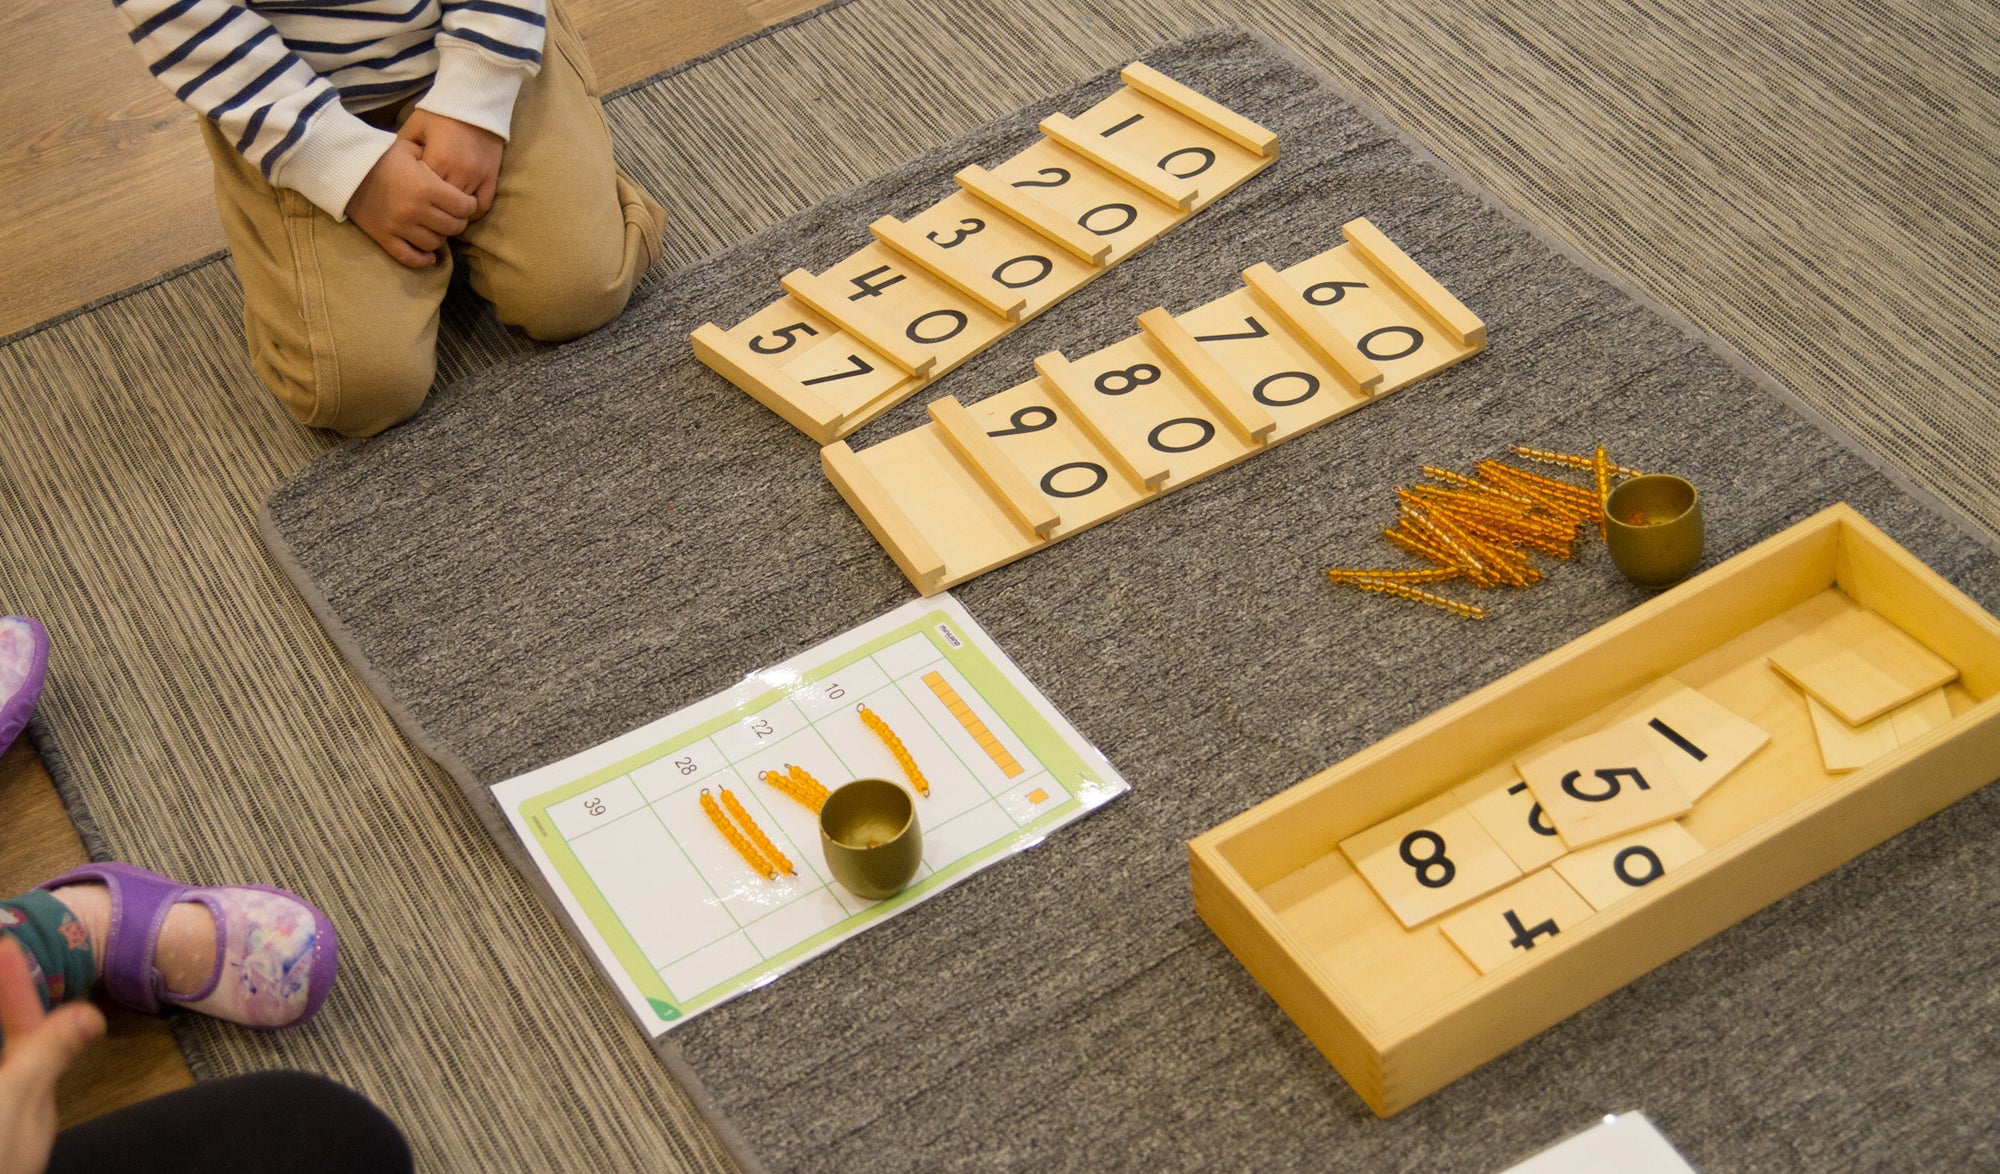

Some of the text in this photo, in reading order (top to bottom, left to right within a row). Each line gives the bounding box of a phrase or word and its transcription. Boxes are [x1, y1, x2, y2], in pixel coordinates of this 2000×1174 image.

[825, 683, 845, 700] 10
[751, 719, 773, 739] 22
[674, 756, 697, 775] 28
[1561, 767, 1651, 802] 5
[584, 797, 606, 816] 39
[1399, 829, 1456, 888] 8
